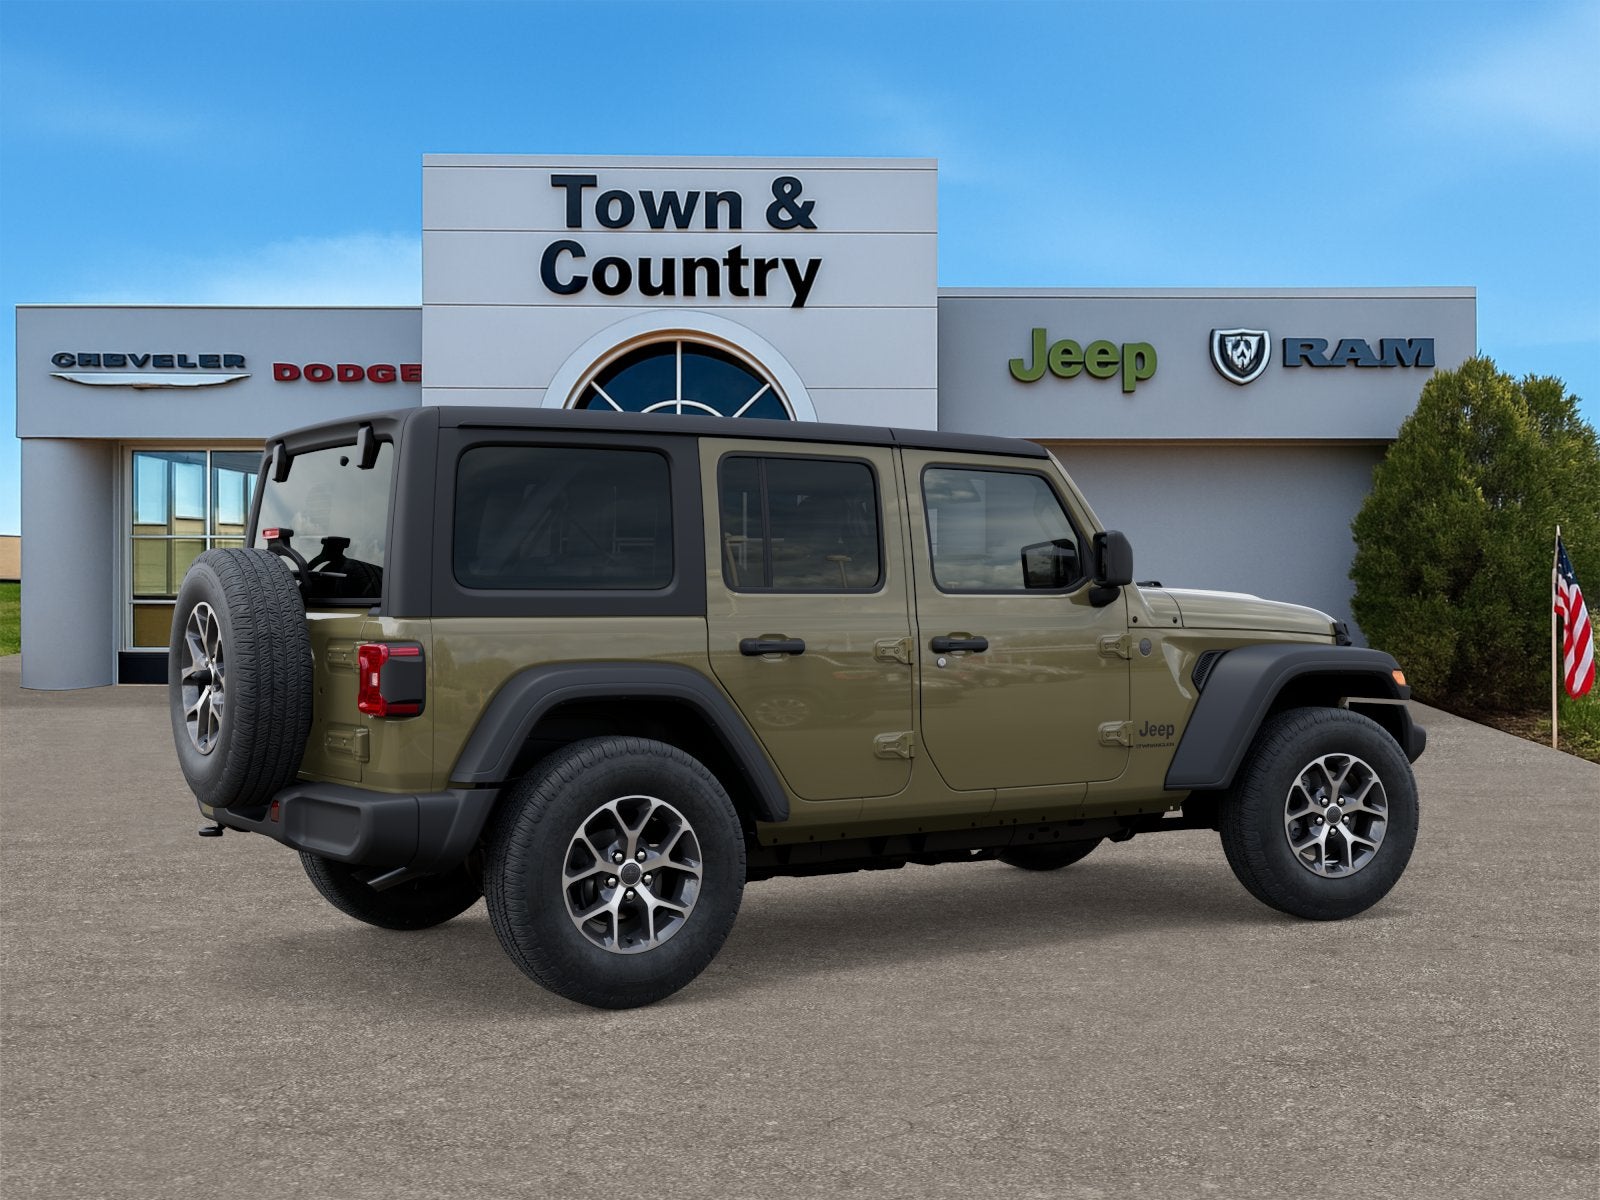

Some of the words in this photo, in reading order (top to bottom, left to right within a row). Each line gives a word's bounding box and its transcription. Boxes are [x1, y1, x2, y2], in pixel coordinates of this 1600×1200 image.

[550, 174, 743, 229] Town
[765, 175, 818, 230] &
[540, 239, 822, 308] Country
[273, 362, 422, 383] DODGE
[1008, 328, 1158, 393] Jeep
[1282, 337, 1436, 368] RAM
[1139, 720, 1175, 739] Jeep
